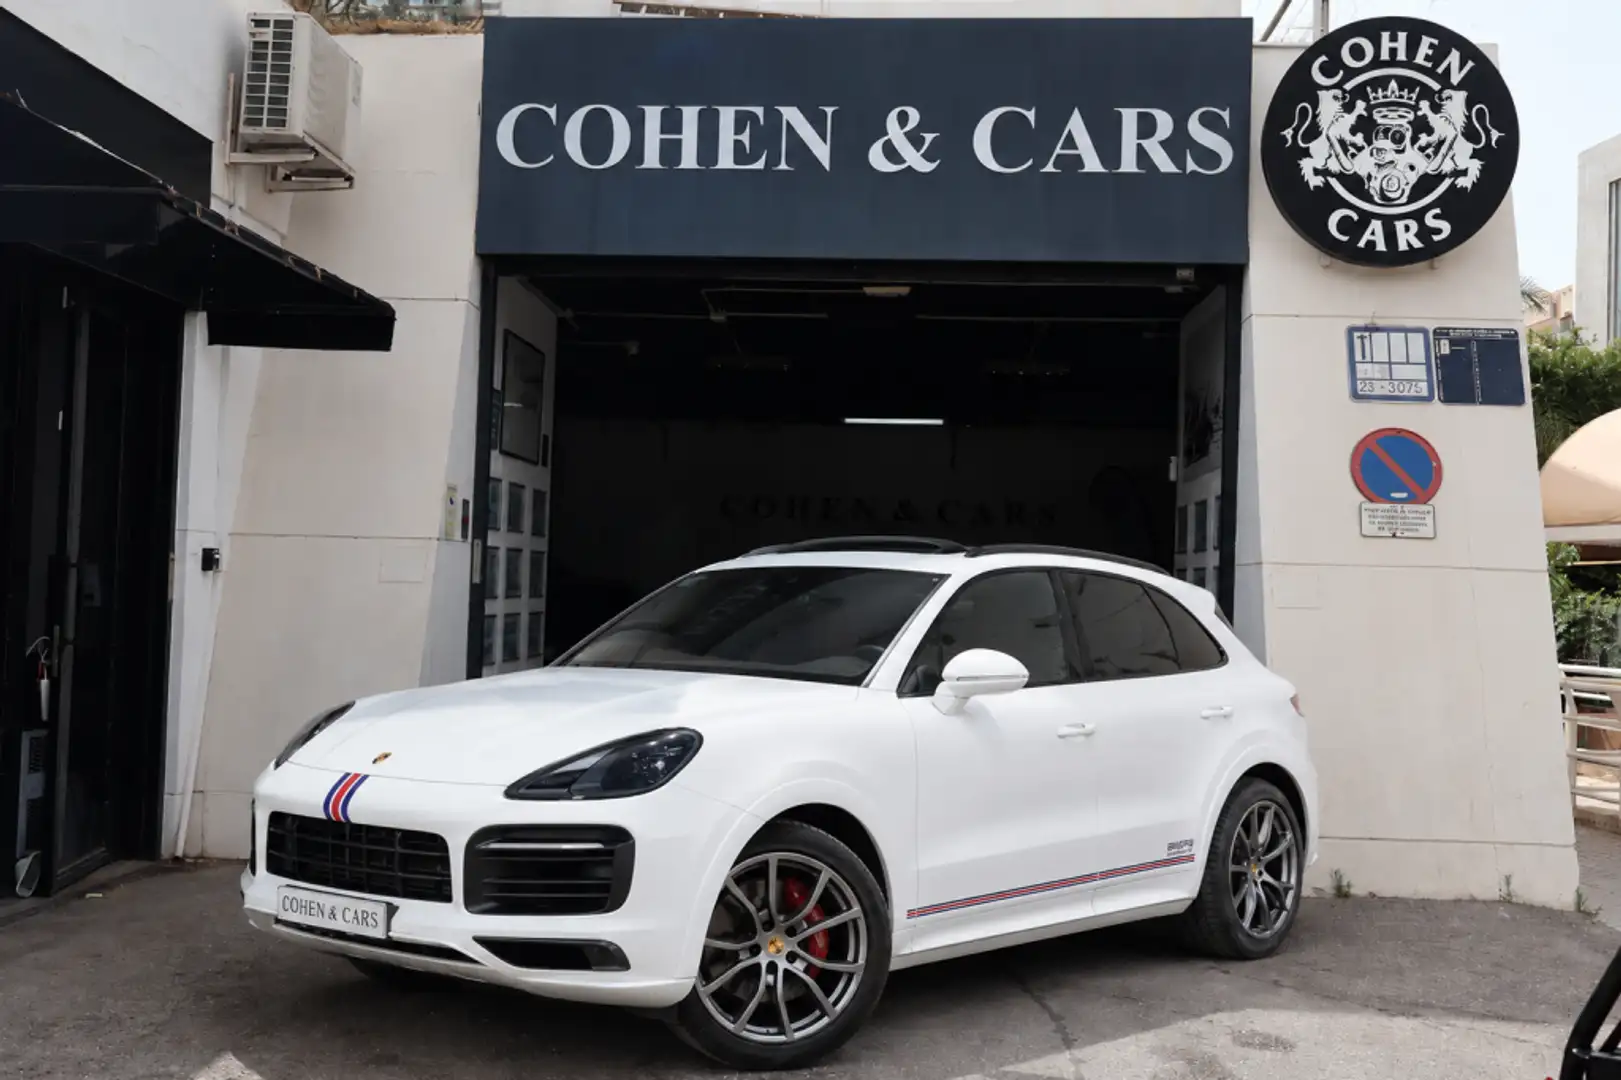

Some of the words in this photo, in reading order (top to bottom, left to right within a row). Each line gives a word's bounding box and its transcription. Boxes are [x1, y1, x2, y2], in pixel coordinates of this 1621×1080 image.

[1311, 31, 1475, 87] COHEN
[496, 103, 839, 172] COHEN
[868, 106, 941, 173] &
[972, 106, 1234, 175] CARS
[1327, 208, 1451, 252] CARS
[1359, 381, 1375, 393] 23
[1388, 382, 1423, 394] 3075
[282, 895, 326, 919] COHEN
[328, 906, 337, 921] &
[342, 907, 378, 929] CARS
